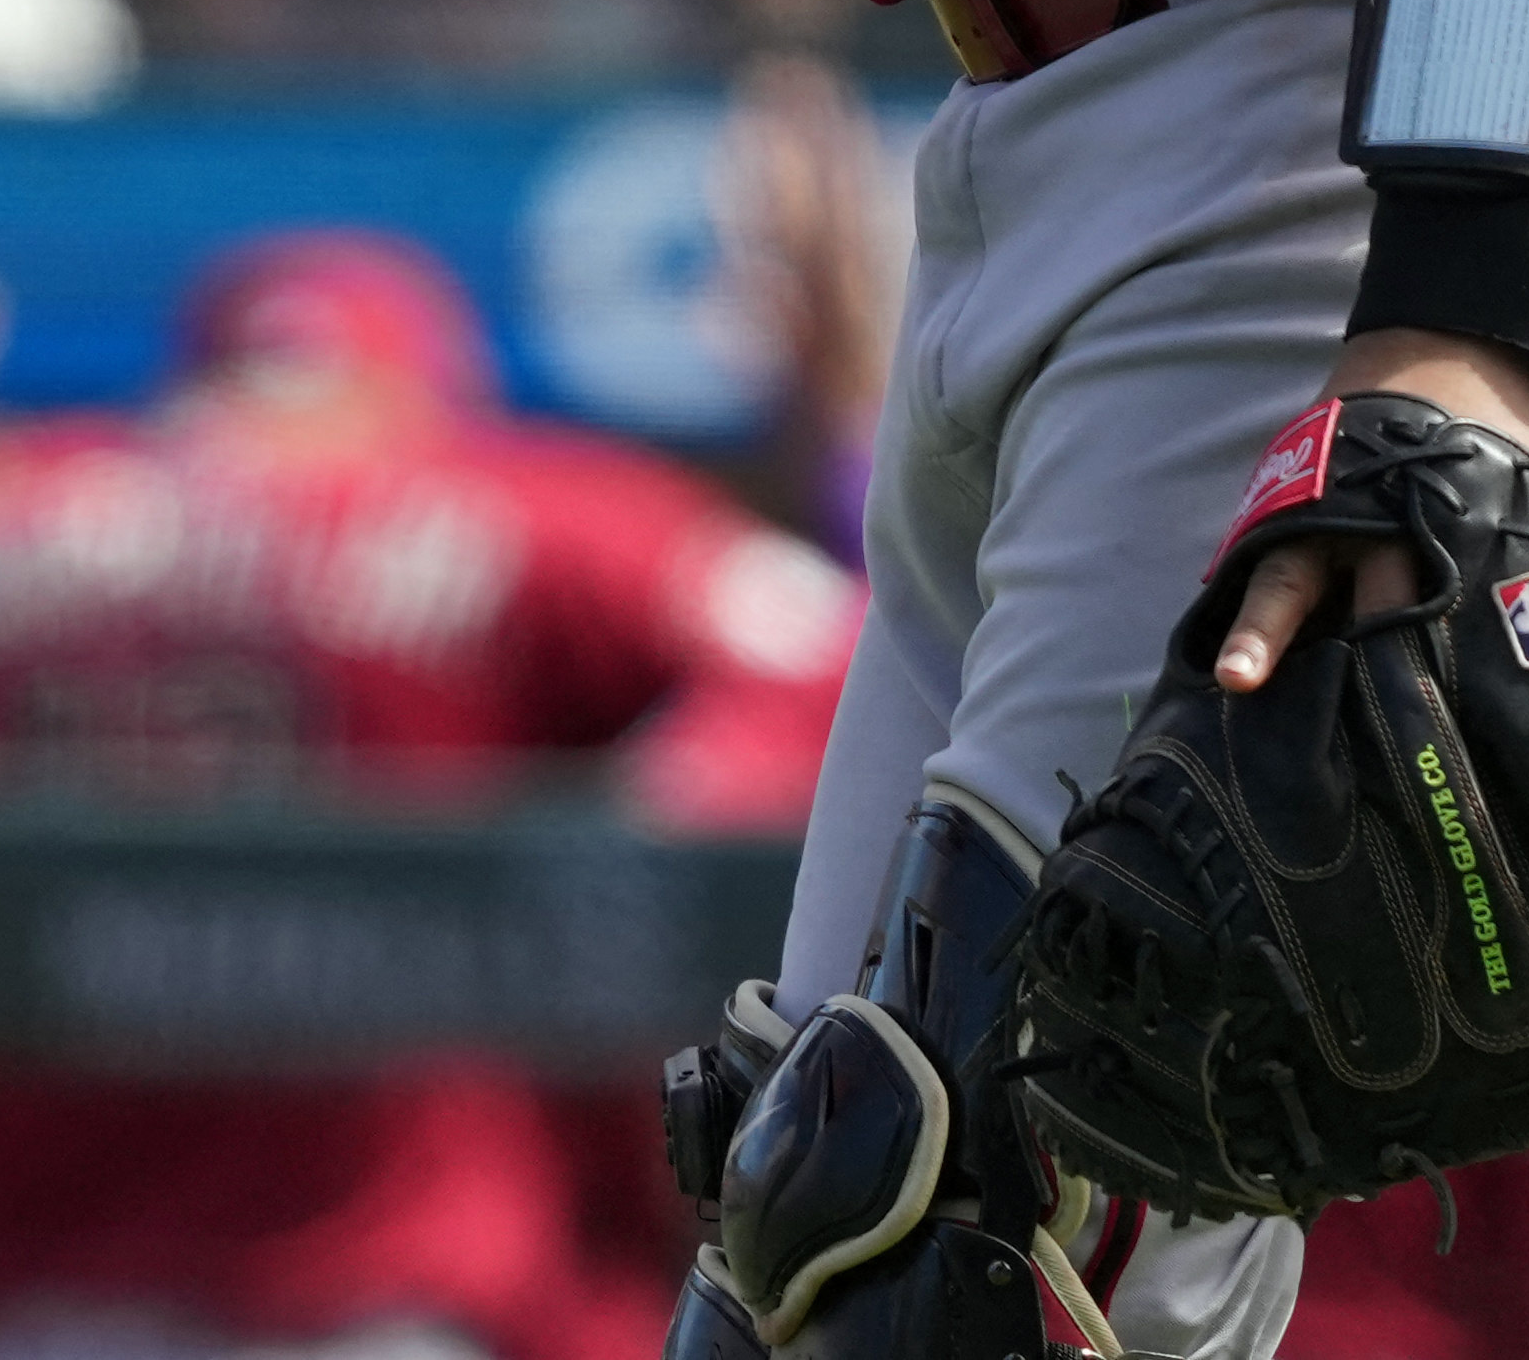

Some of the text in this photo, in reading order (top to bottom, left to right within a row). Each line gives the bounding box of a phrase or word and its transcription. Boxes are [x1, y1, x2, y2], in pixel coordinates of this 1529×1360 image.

[1417, 743, 1511, 995] THE GOLD GLOVE CO.
